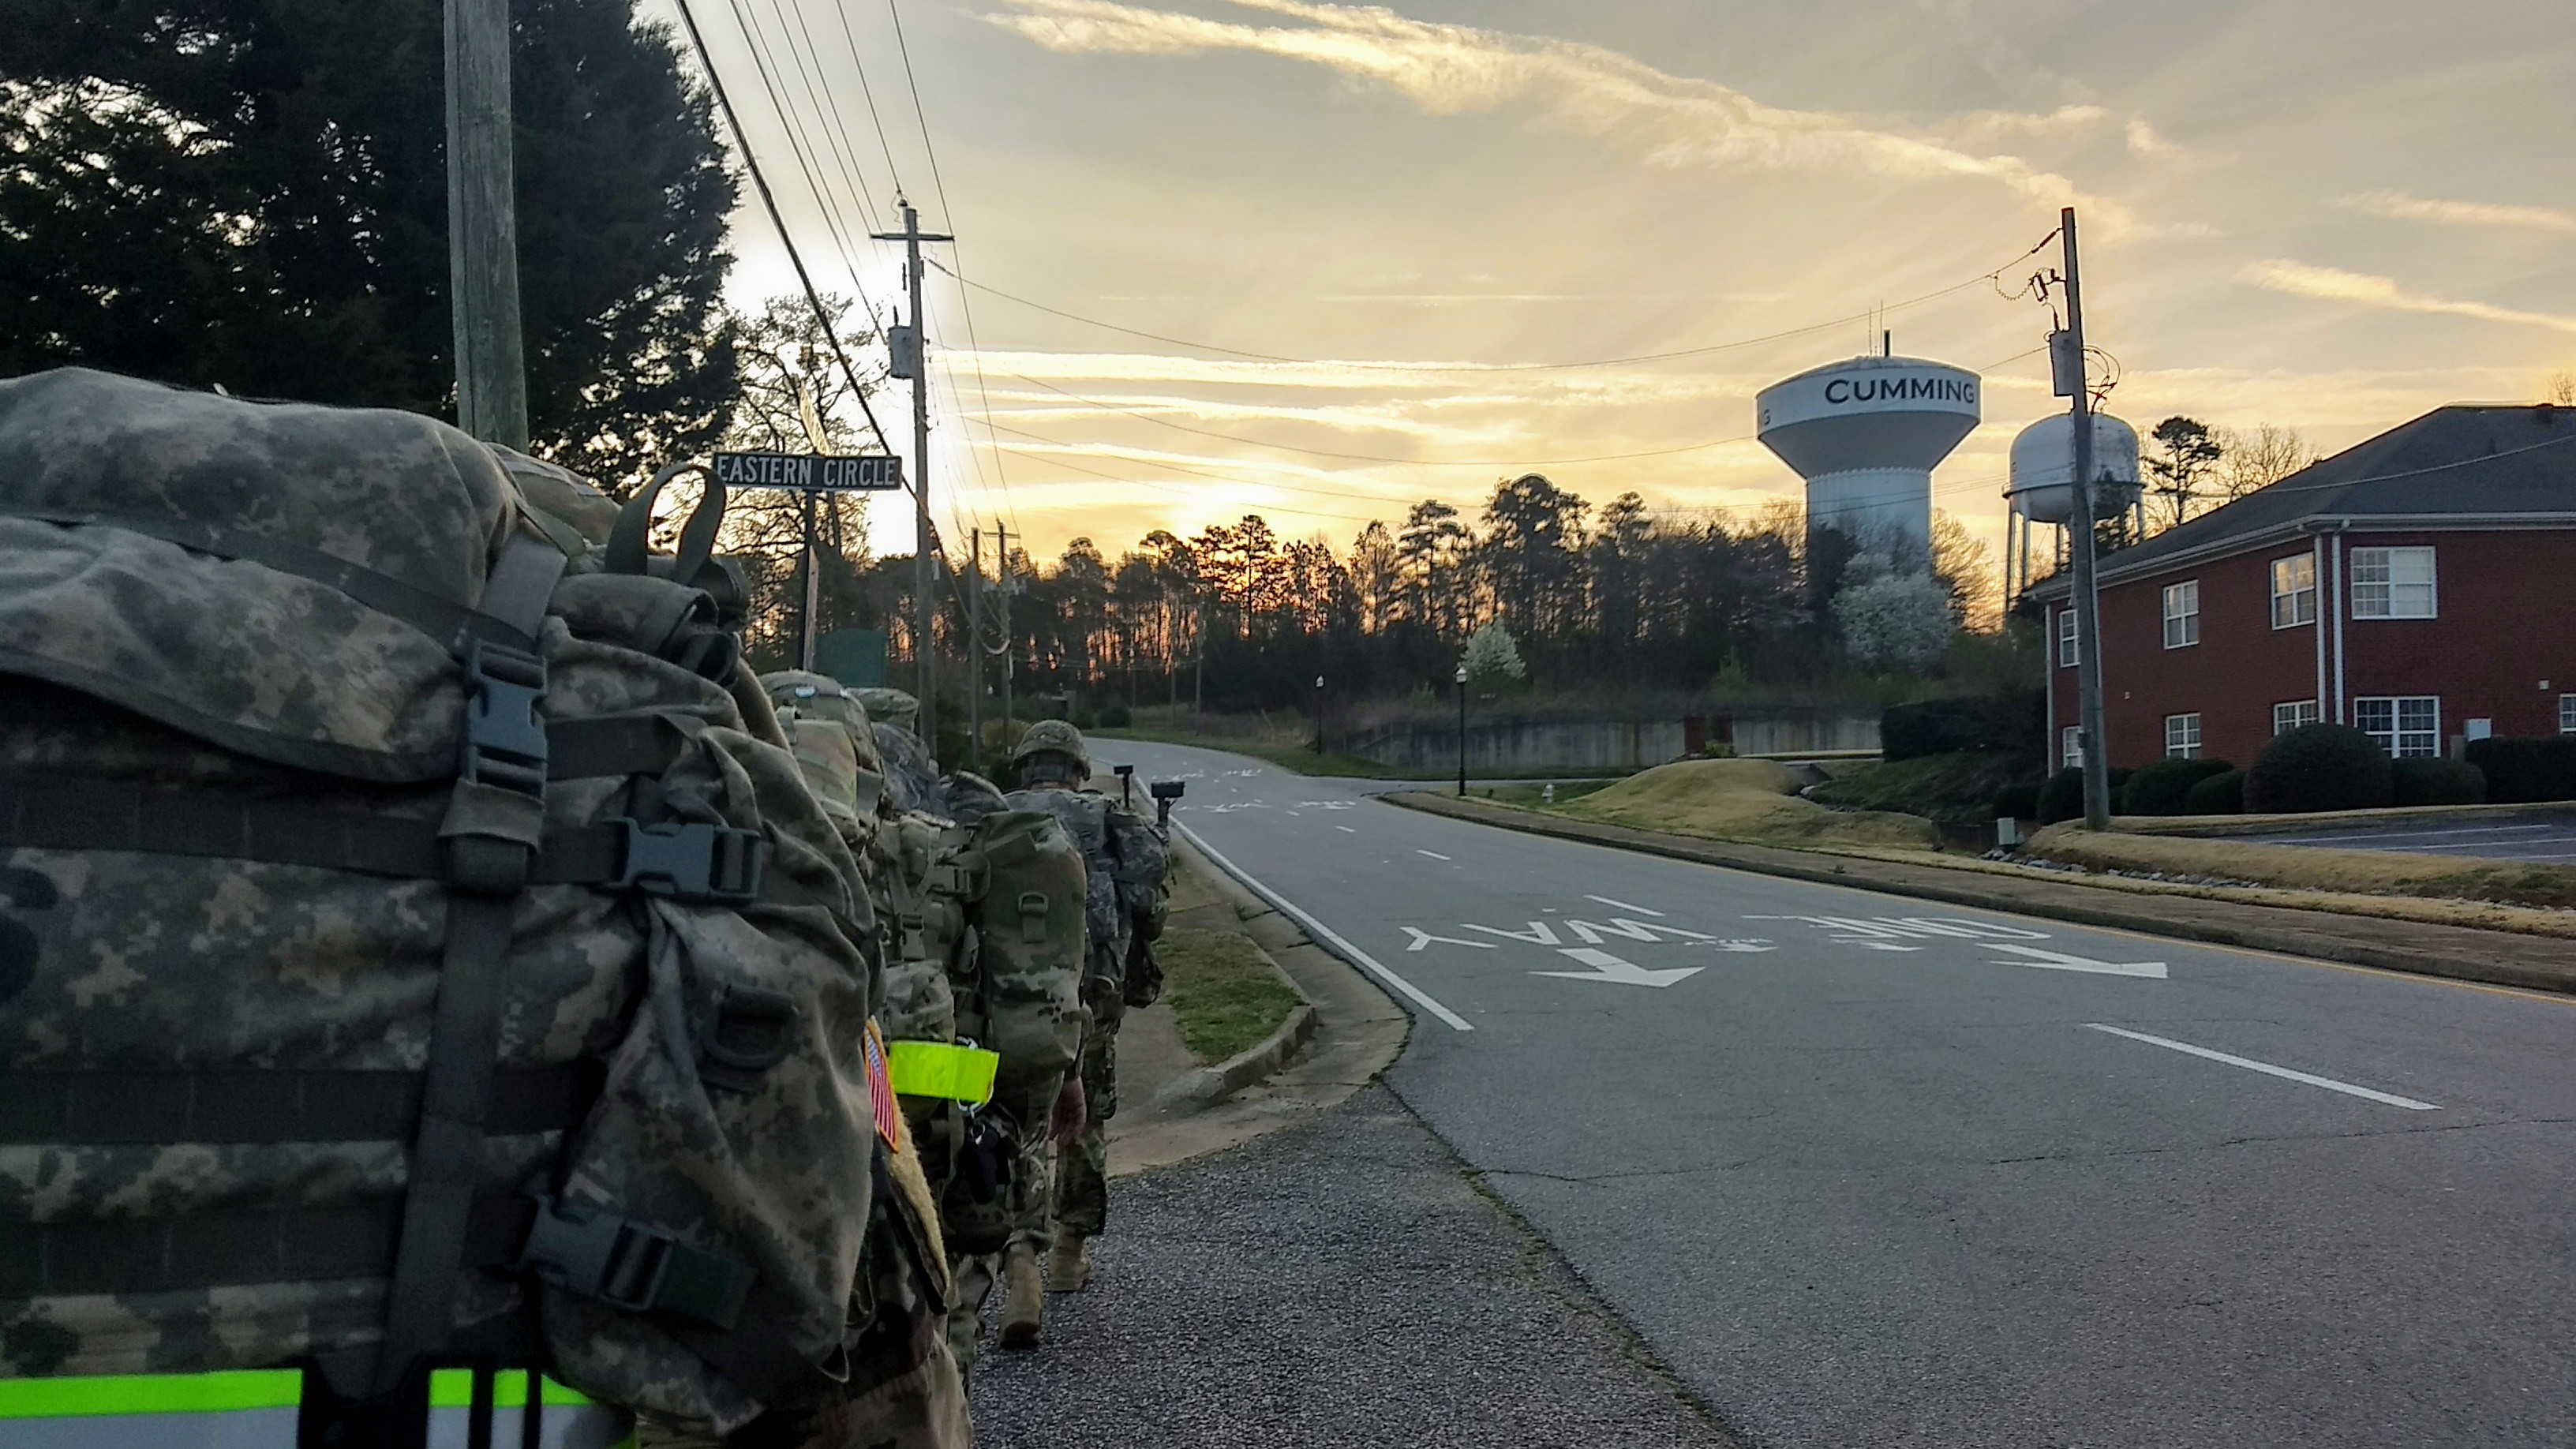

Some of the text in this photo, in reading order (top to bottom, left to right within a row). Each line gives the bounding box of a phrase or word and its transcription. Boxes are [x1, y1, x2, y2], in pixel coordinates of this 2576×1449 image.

[1825, 379, 1975, 404] CUMMING
[717, 455, 897, 486] EASTERN CIRCLE
[1399, 918, 1717, 952] WAY
